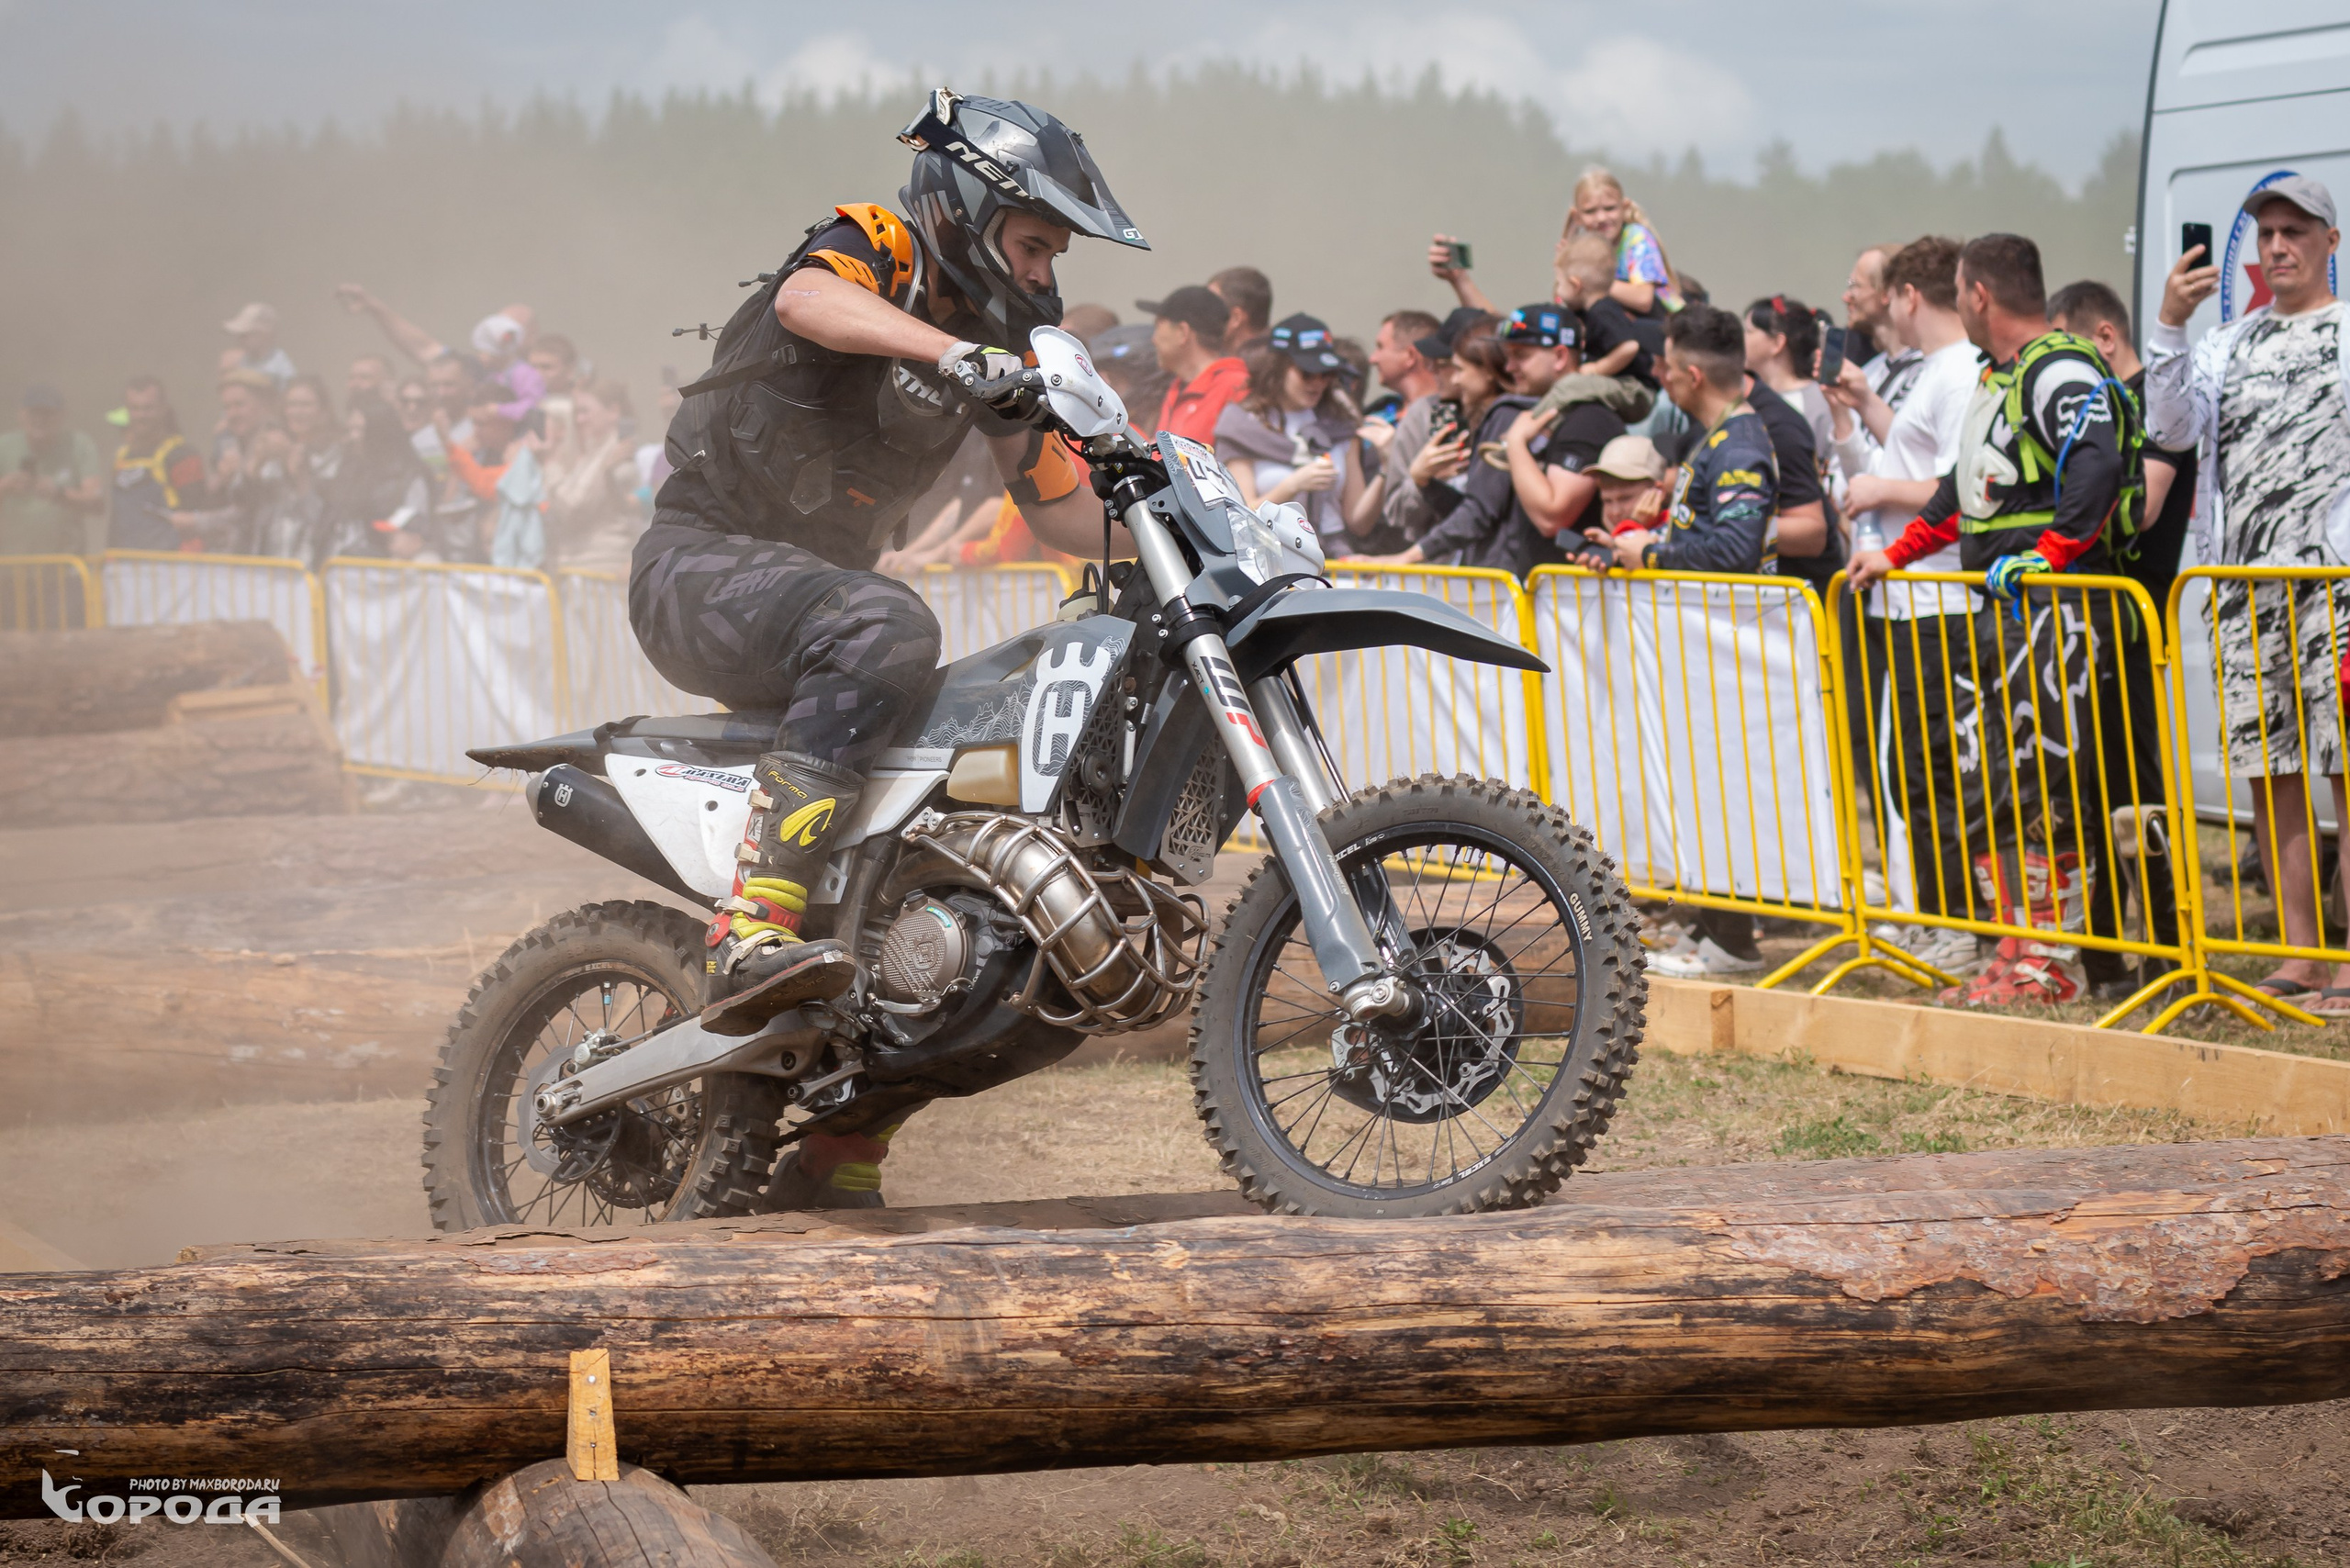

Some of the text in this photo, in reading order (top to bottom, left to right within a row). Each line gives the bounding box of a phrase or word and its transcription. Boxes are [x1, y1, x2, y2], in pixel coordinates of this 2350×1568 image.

[946, 141, 1035, 199] NEN
[703, 566, 803, 605] LEATT
[1192, 661, 1205, 684] XACT
[1334, 843, 1361, 861] XCEL
[1569, 892, 1593, 941] GUMMY
[585, 962, 612, 971] EXCEL
